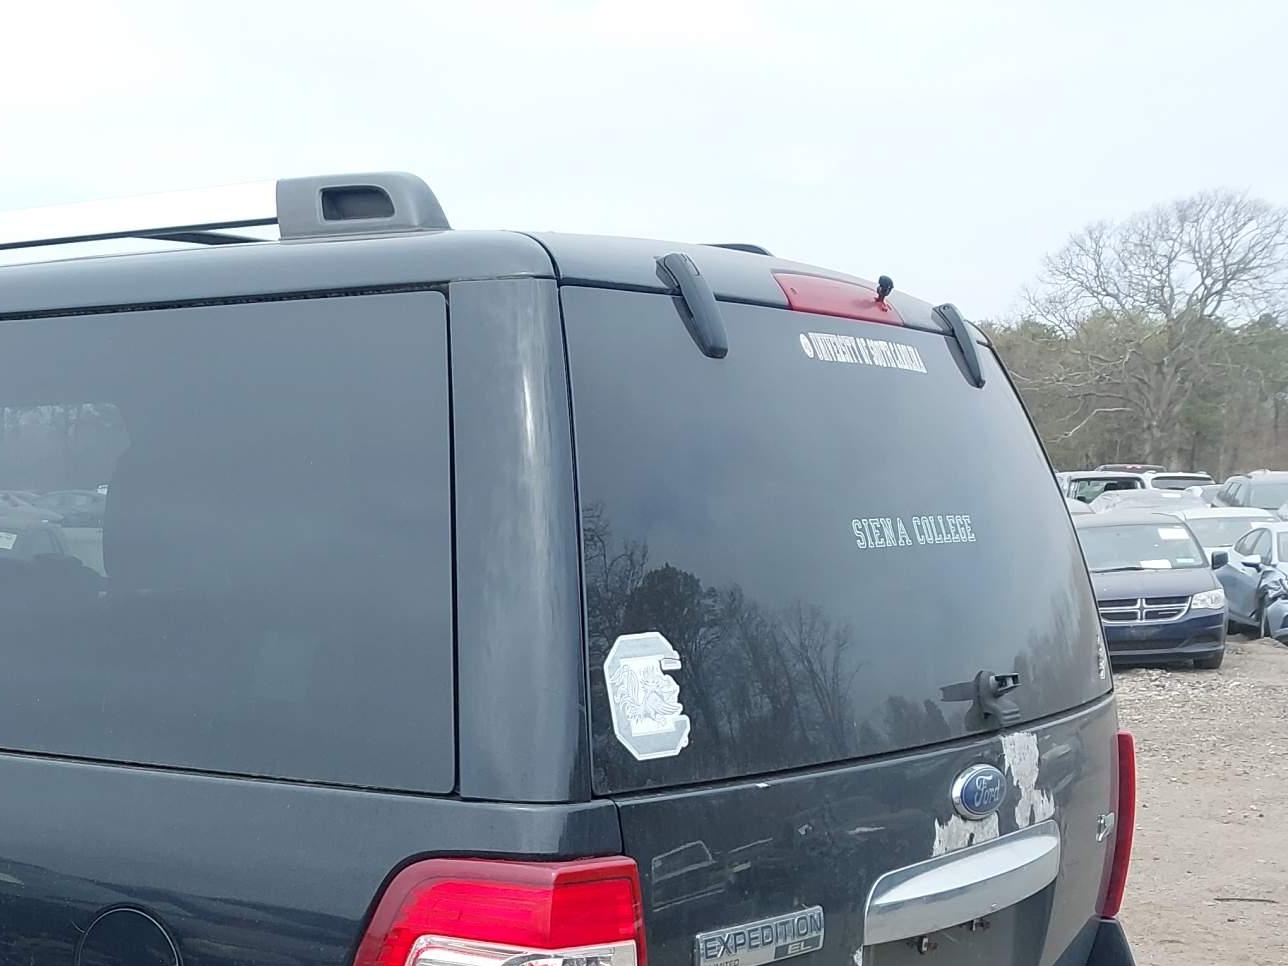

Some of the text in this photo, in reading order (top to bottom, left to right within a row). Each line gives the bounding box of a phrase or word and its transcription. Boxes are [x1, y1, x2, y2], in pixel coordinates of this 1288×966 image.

[852, 515, 976, 548] SIENA COLLEGE
[974, 774, 1001, 807] Ford
[704, 912, 822, 959] EXPEDITION
[787, 942, 812, 955] EL
